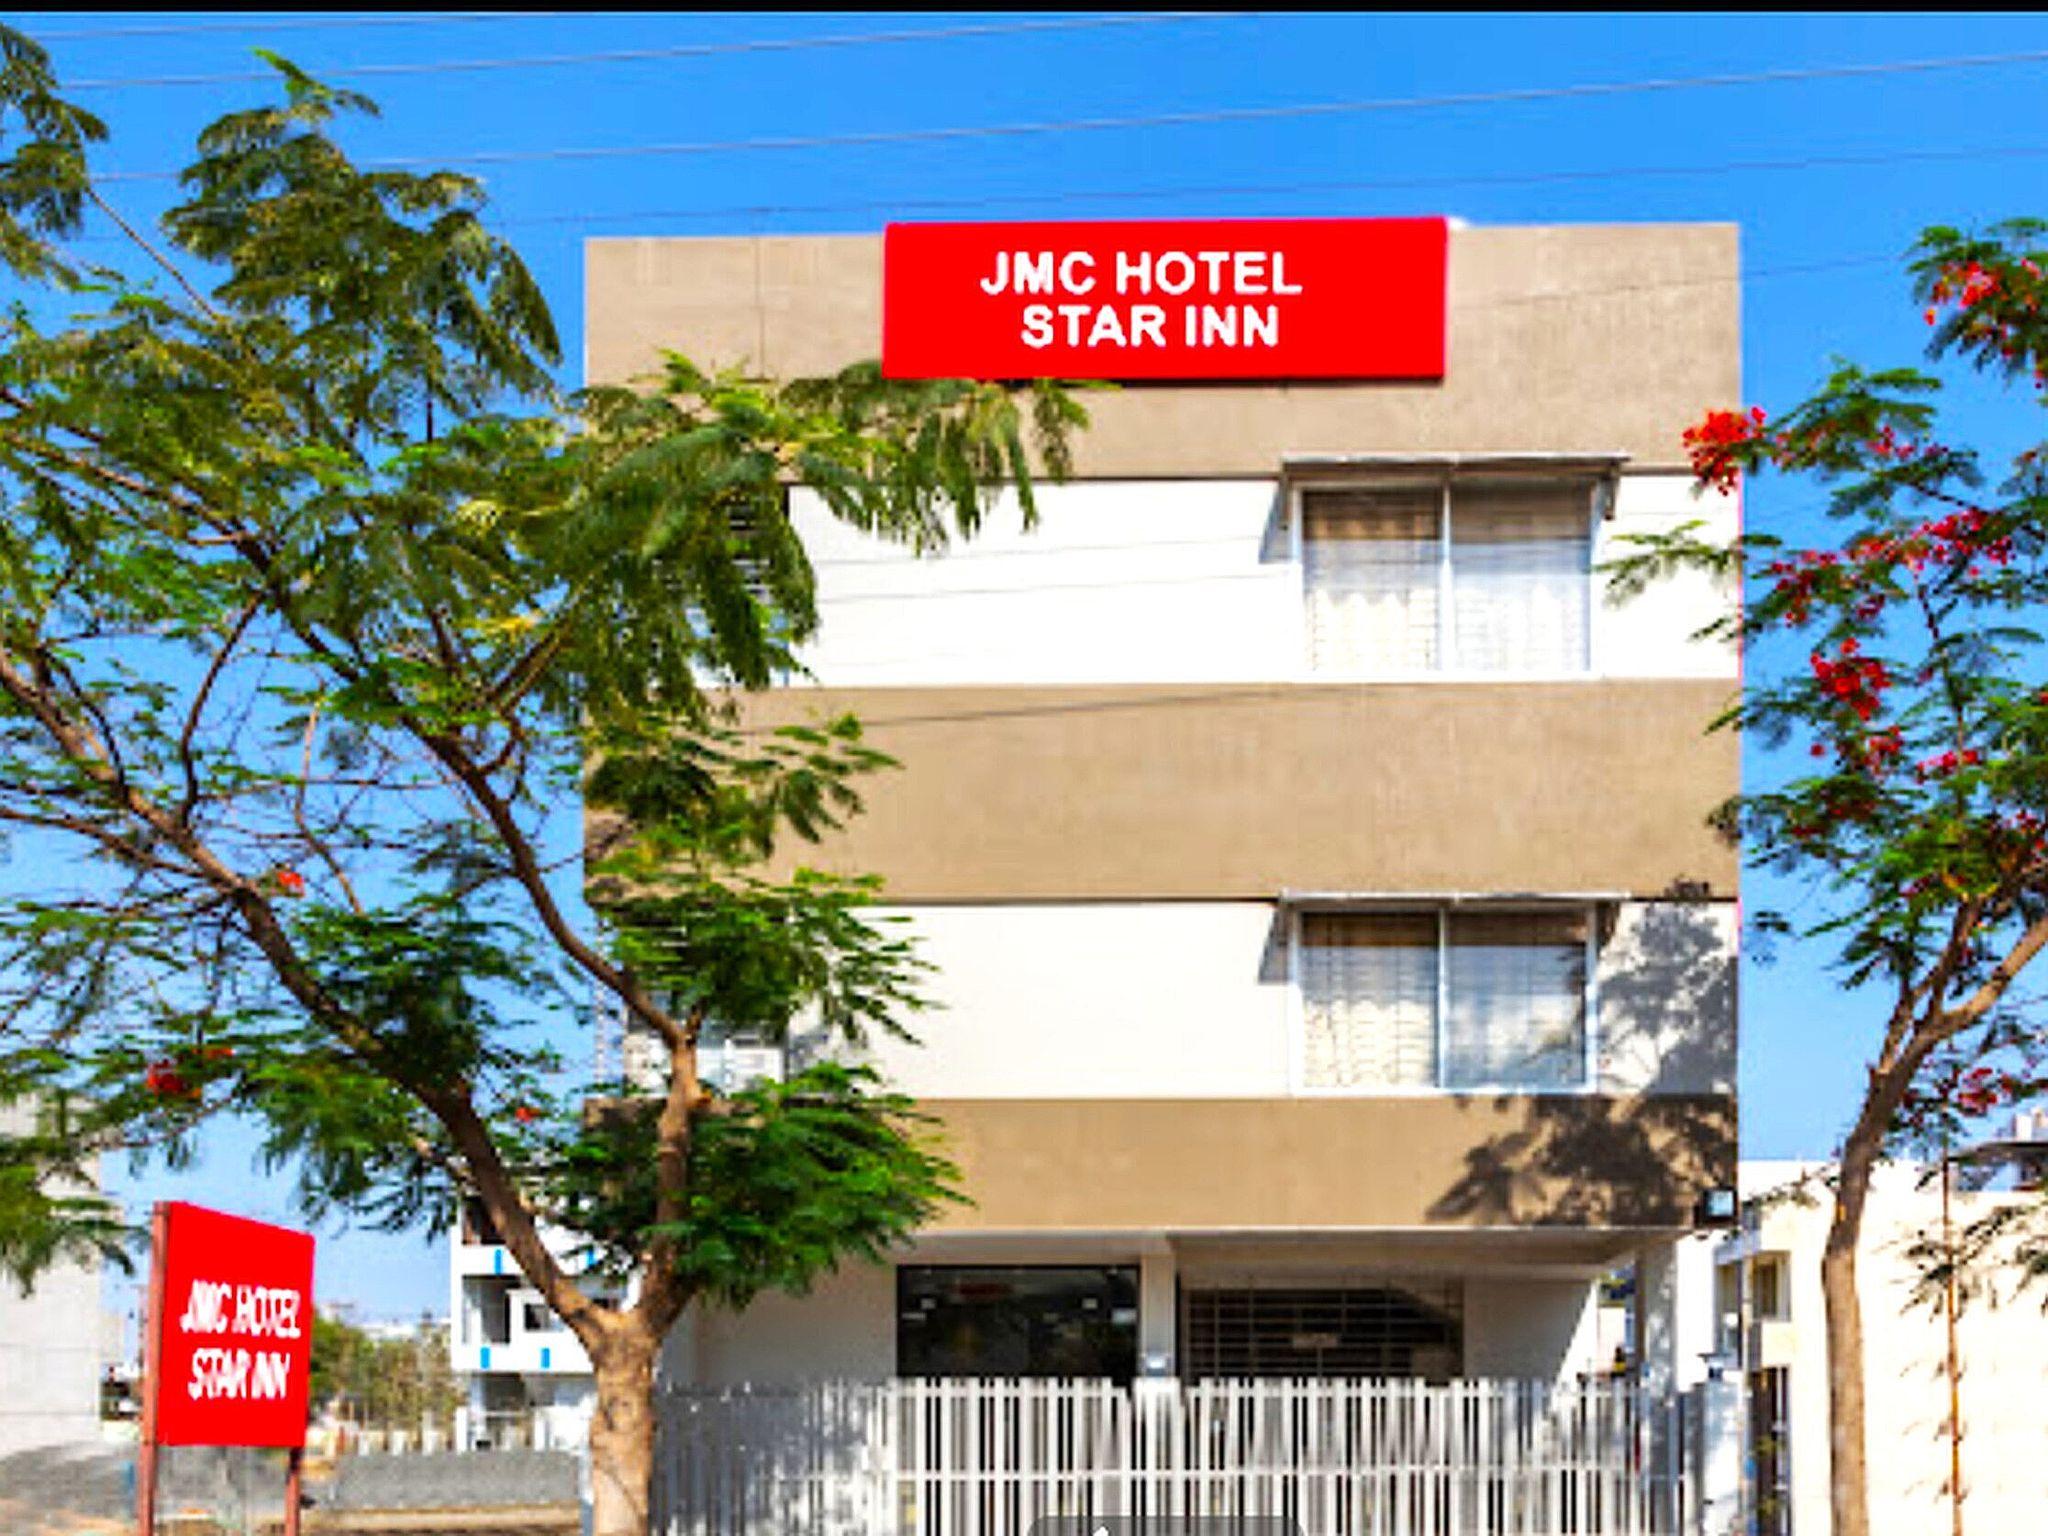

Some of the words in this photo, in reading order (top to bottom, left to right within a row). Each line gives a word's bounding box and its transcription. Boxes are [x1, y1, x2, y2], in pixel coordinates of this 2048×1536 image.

[980, 251, 1096, 295] JMC
[1116, 251, 1303, 295] HOTEL
[1021, 304, 1167, 349] STAR
[1185, 304, 1278, 347] INN
[180, 1279, 232, 1334] JMC
[232, 1284, 301, 1339] HOTEL
[187, 1347, 251, 1400] STAR
[251, 1351, 291, 1400] INN
